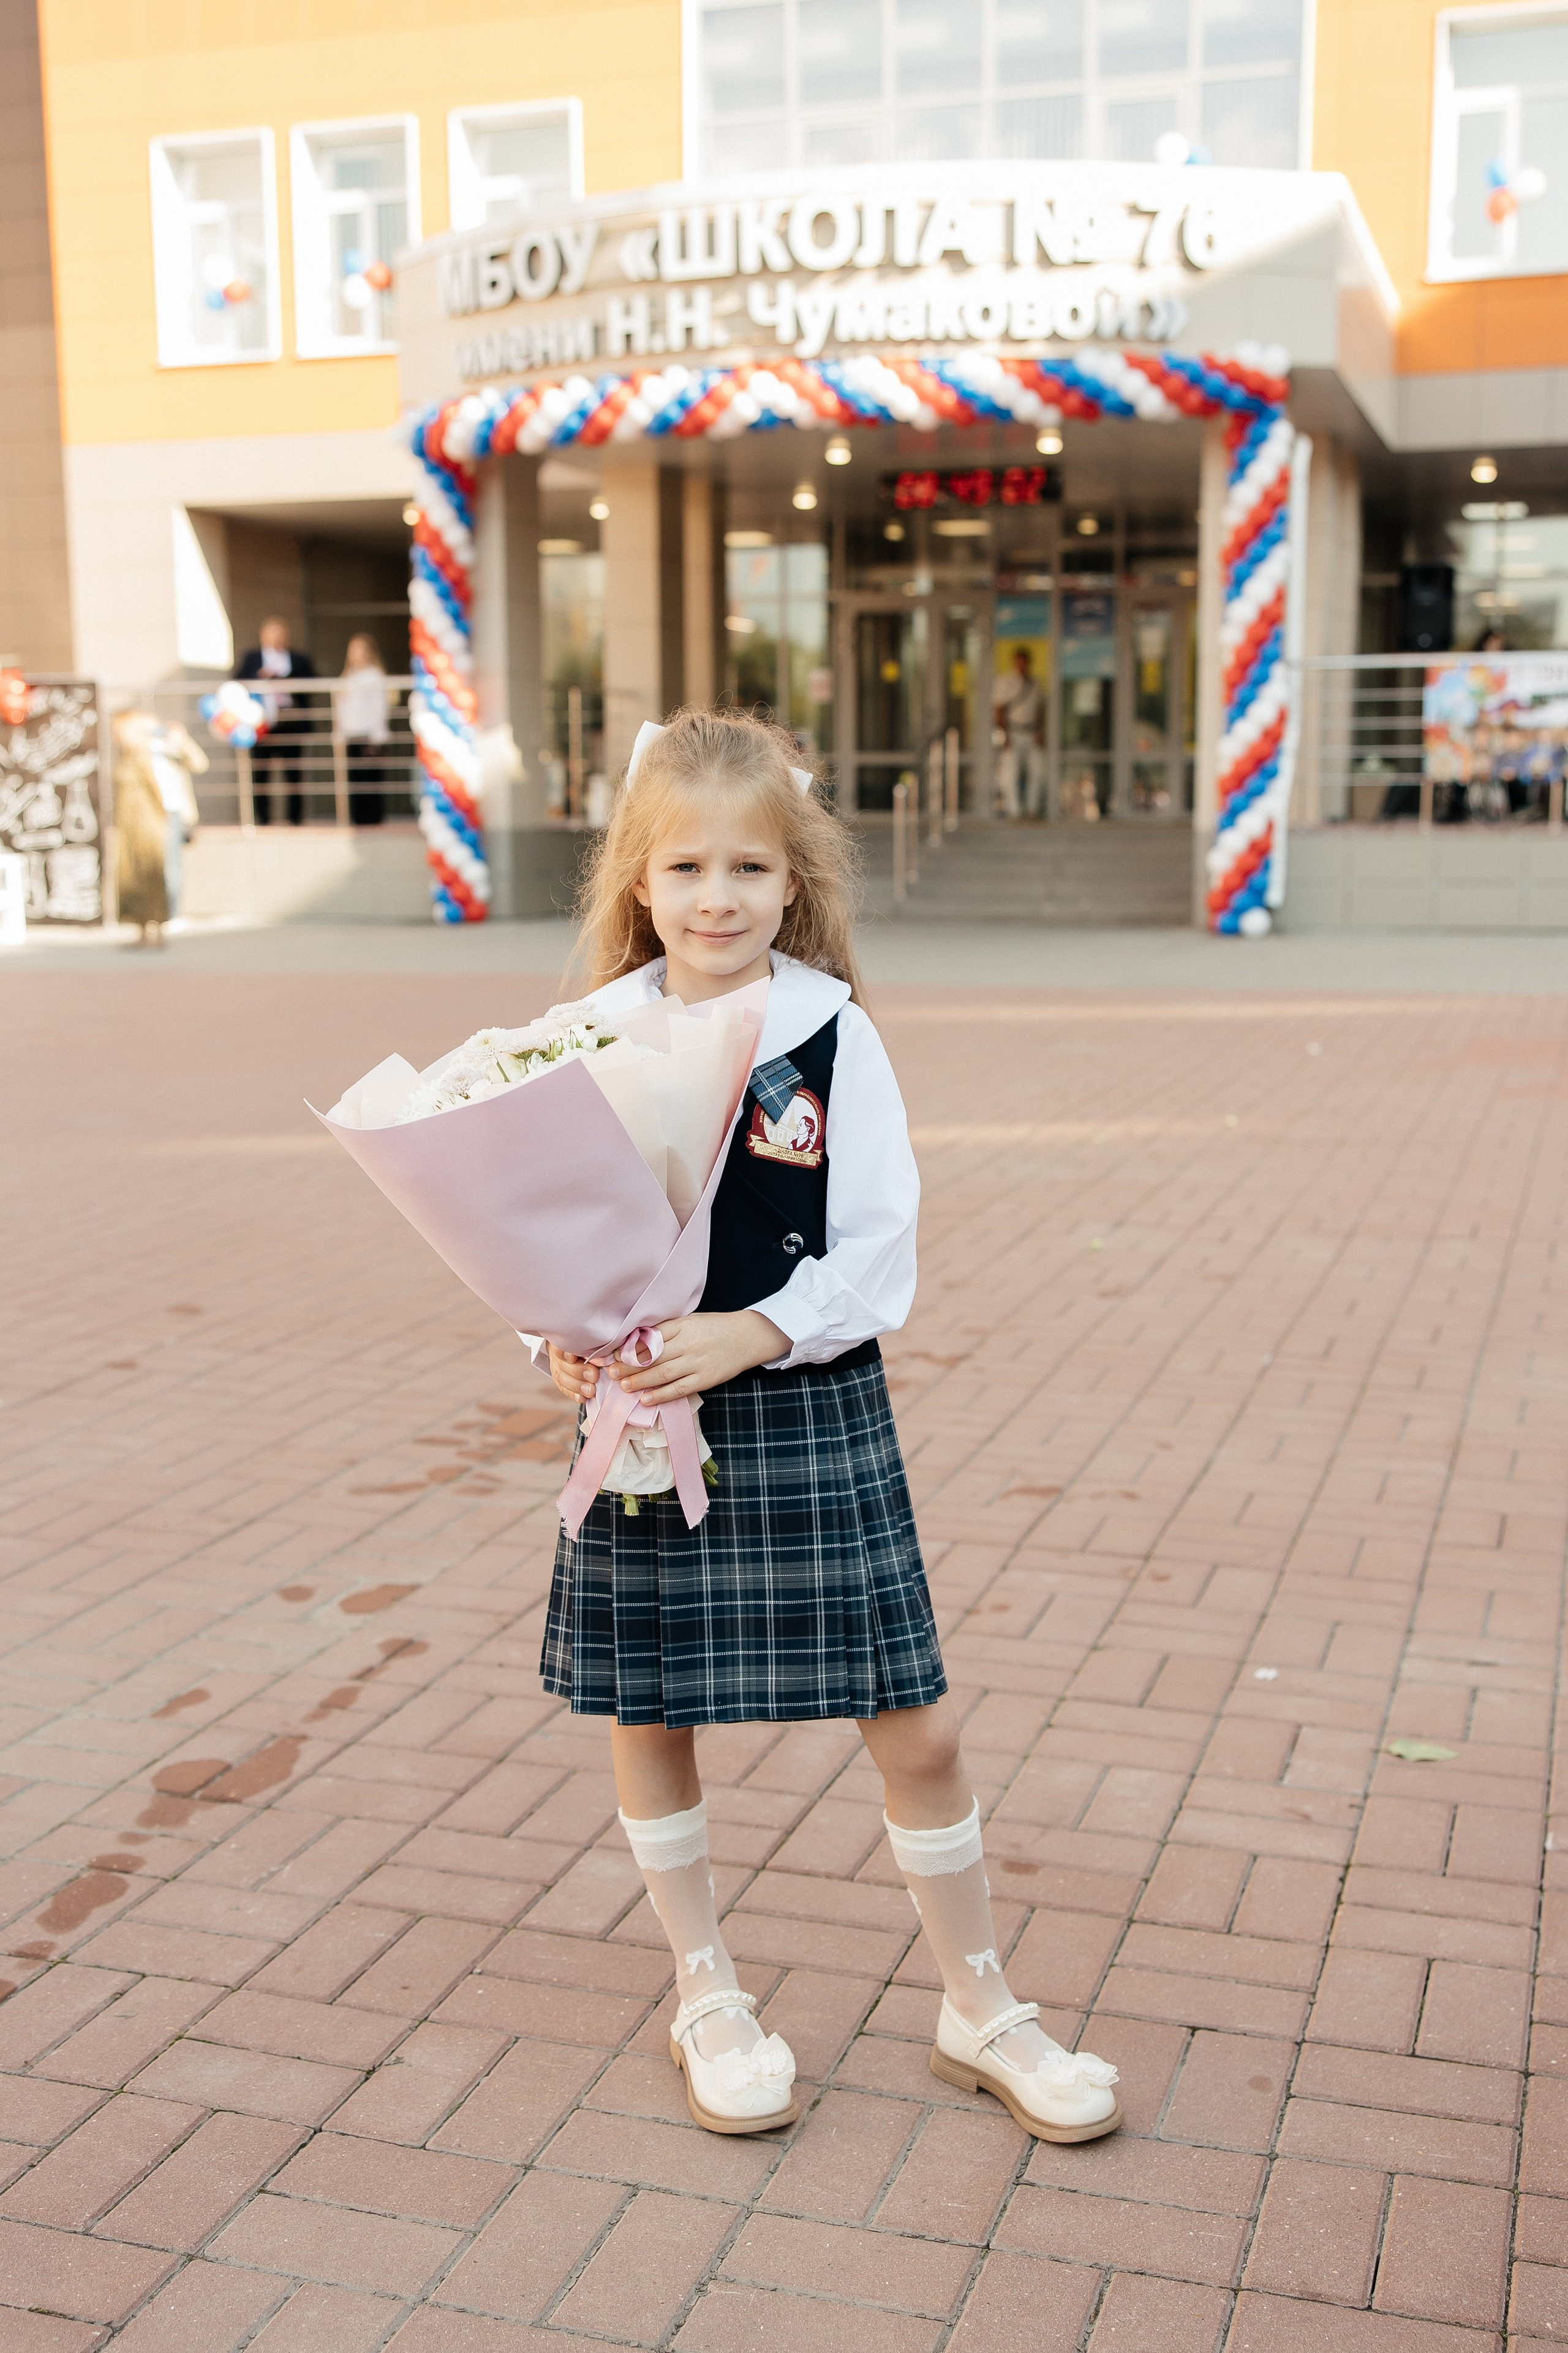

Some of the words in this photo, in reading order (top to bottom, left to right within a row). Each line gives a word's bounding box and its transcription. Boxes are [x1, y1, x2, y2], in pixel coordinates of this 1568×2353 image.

[441, 221, 602, 317] МБОУ
[618, 194, 978, 283] «ШКОЛА
[1126, 195, 1234, 272] 76
[605, 287, 732, 358] Н.Н.
